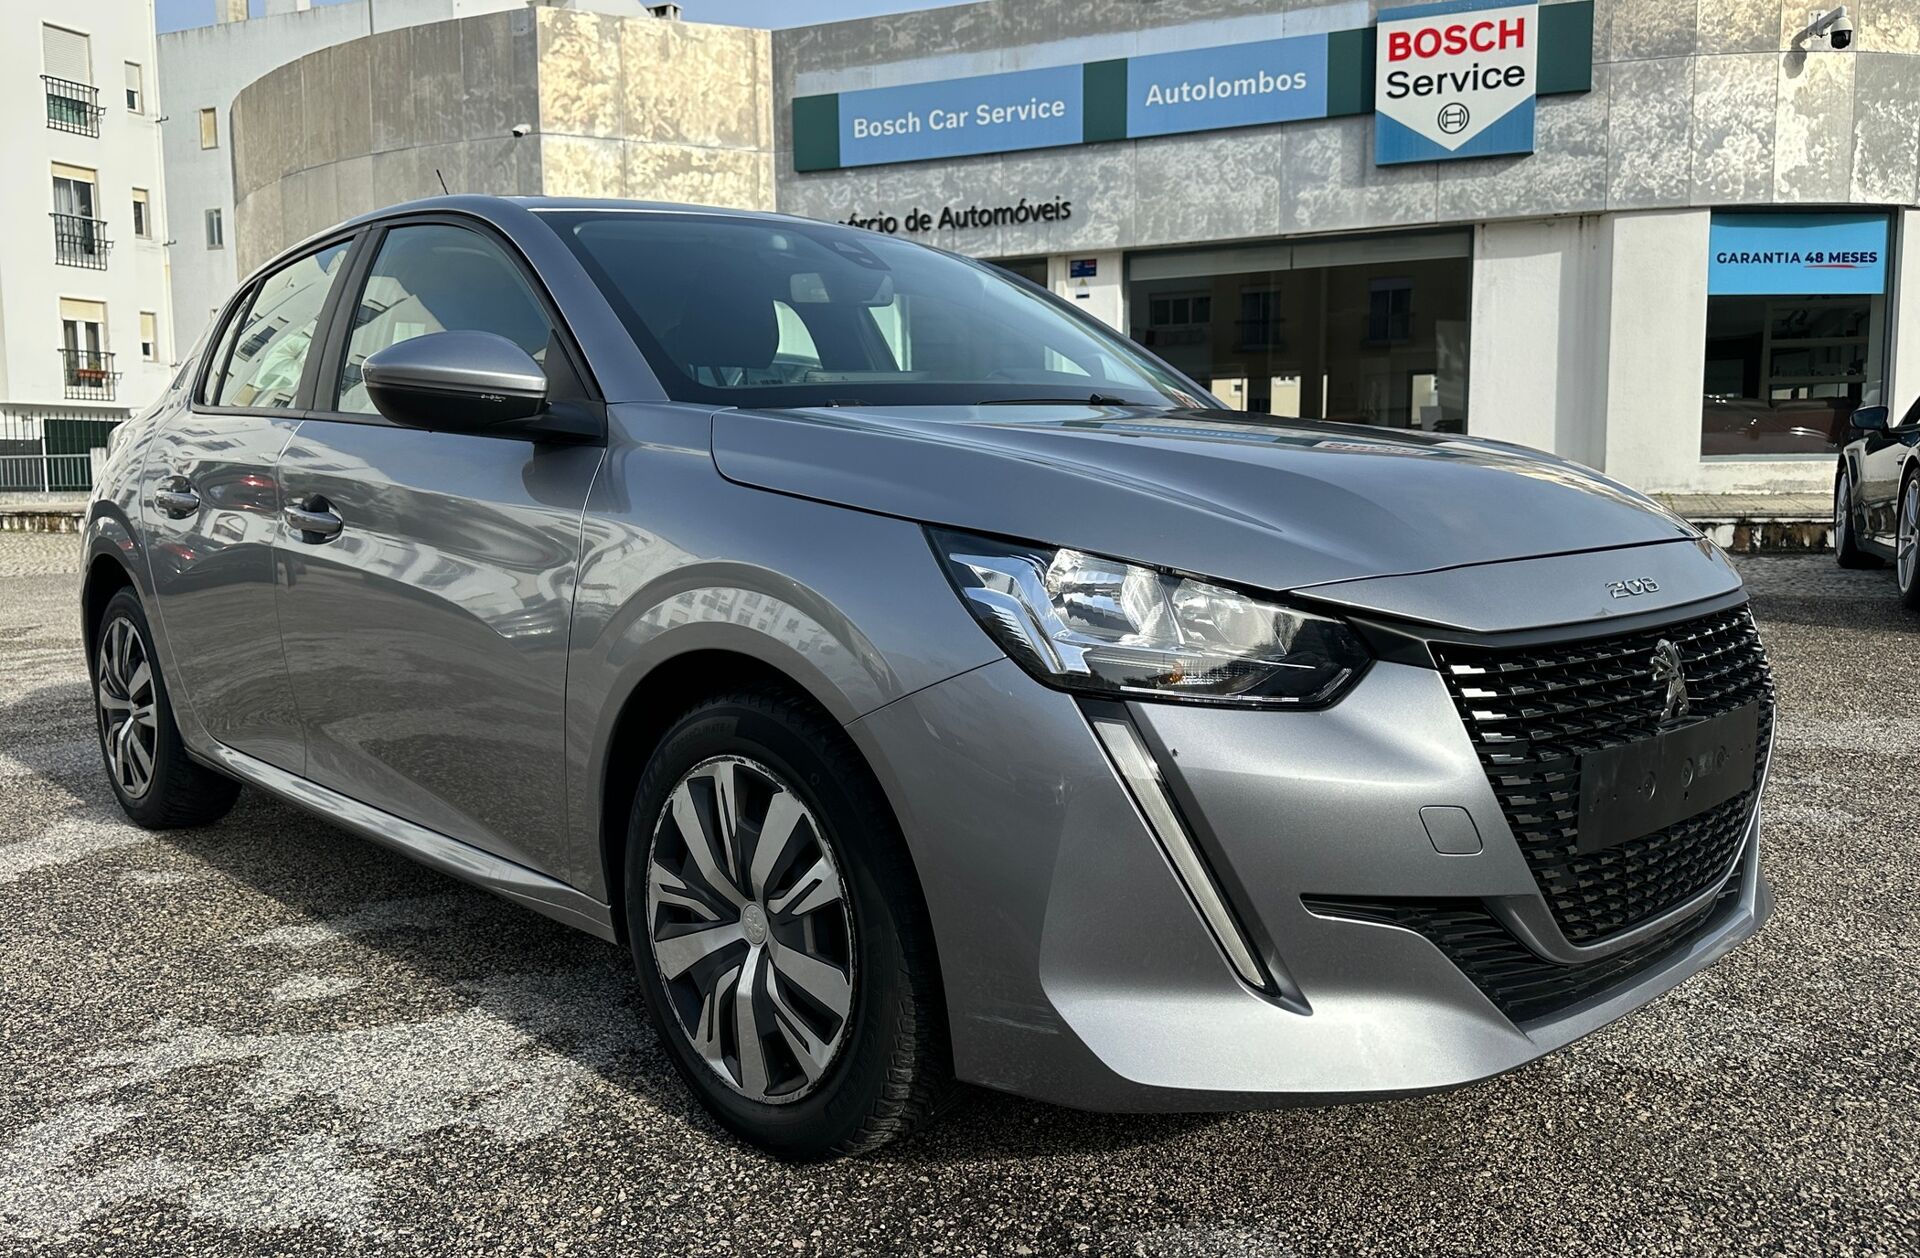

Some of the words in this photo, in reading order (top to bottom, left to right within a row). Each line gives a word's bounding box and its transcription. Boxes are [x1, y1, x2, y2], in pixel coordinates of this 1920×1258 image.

[1388, 17, 1525, 62] BOSCH
[1145, 70, 1307, 107] Autolombos
[1386, 63, 1525, 99] Service
[853, 111, 921, 138] Bosch
[928, 109, 969, 130] Car
[975, 97, 1065, 126] Service
[838, 210, 899, 235] ércio
[905, 208, 932, 232] de
[938, 195, 1072, 230] Automóveis
[1716, 252, 1801, 264] GARANTIA
[1804, 251, 1825, 263] 48
[1828, 251, 1878, 264] MESES
[1605, 576, 1660, 599] 208
